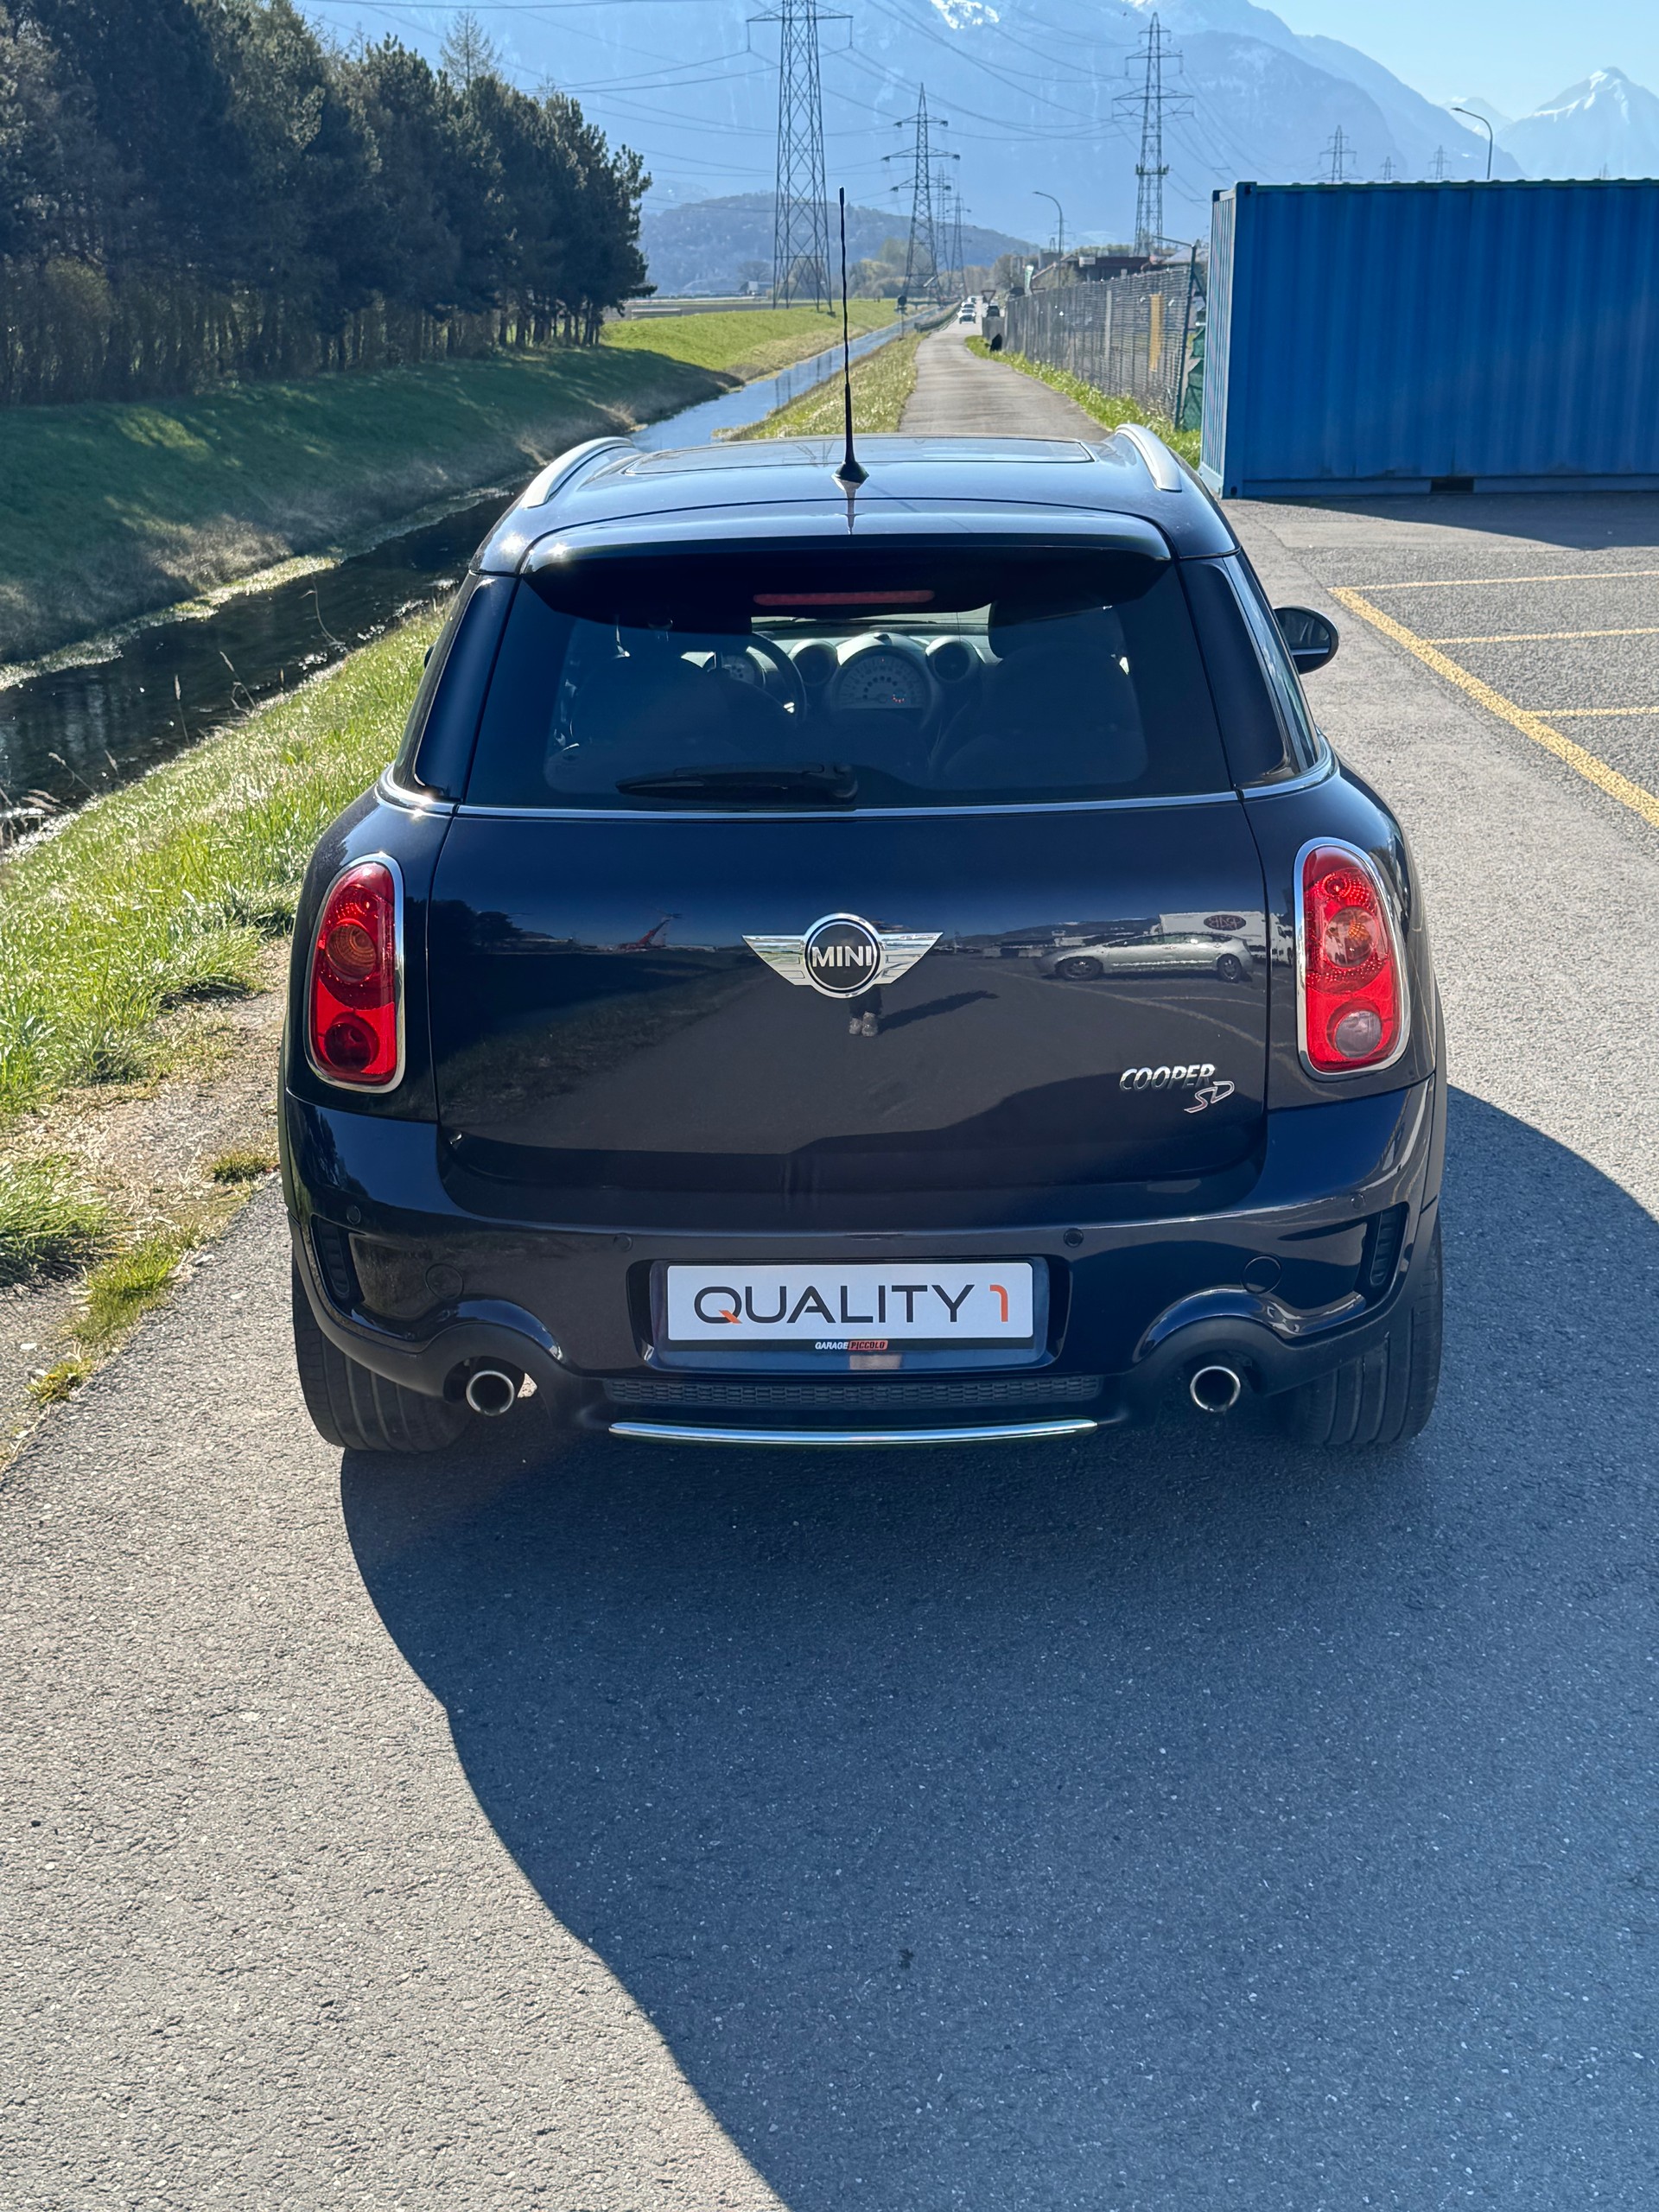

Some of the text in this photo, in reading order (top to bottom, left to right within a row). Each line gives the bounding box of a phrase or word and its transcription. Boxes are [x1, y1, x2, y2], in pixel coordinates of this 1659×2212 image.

[812, 946, 873, 967] MINI
[1119, 1063, 1215, 1091] COOPER
[1183, 1080, 1236, 1114] SD
[694, 1284, 1009, 1324] QUALITY 1
[815, 1341, 886, 1350] GARAGE PICCOLO
